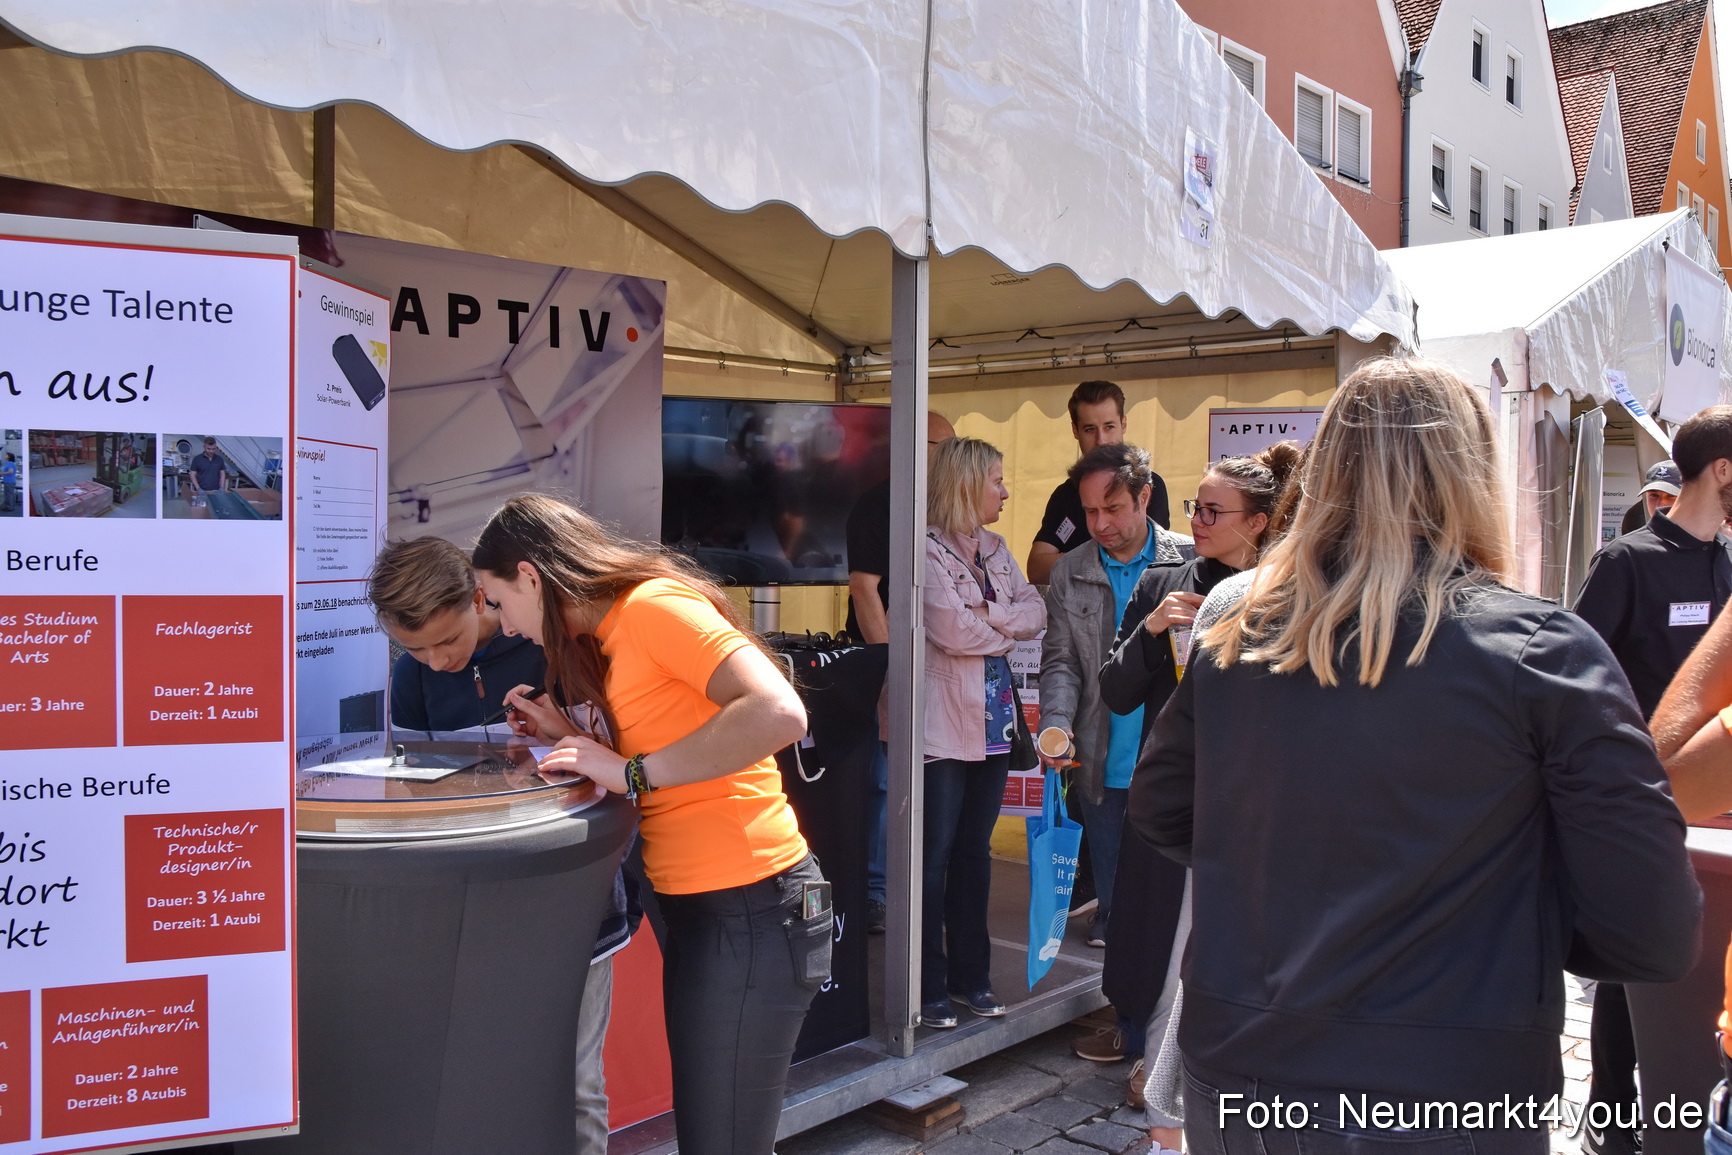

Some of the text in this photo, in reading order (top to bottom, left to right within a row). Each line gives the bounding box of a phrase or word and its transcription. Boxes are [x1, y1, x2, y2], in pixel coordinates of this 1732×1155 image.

[1200, 223, 1209, 240] 31
[103, 290, 234, 324] Talente
[320, 295, 374, 326] Gewinnspiel
[391, 286, 611, 353] APTIV
[1687, 328, 1716, 369] Bionorica
[48, 364, 154, 403] aus!
[326, 383, 342, 394] 2. Preis
[317, 394, 351, 408] Solar-Powerbank
[1228, 424, 1288, 435] APTIV
[7, 550, 99, 572] Berufe
[301, 602, 314, 610] zum
[314, 599, 338, 609] 29.06.18
[24, 611, 98, 626] Studium
[74, 629, 91, 645] of
[155, 621, 253, 639] Fachlagerist
[315, 630, 329, 640] Ende
[329, 628, 337, 639] Juli
[339, 628, 344, 637] in
[345, 627, 360, 637] unser
[360, 625, 374, 635] Werk
[10, 650, 50, 664] Arts
[304, 645, 334, 659] eingeladen
[154, 682, 254, 698] Dauer: 2 Jahre
[30, 696, 42, 712] 3
[46, 699, 85, 712] Jahre
[149, 706, 259, 722] Derzeit: 1 Azubi
[2, 773, 171, 801] ische Berufe
[153, 821, 259, 840] Technische/r
[168, 840, 244, 857] Produkt-
[160, 857, 252, 877] designer/in
[1052, 853, 1078, 866] Save
[1057, 868, 1065, 880] It
[147, 889, 266, 908] Dauer: 3 ½ Jahre
[153, 912, 261, 932] Derzeit: 1 Azubi
[57, 999, 196, 1026] Maschinen- und
[52, 1017, 200, 1044] Anlagenführer/in
[75, 1062, 180, 1086] Dauer: 2 Jahre
[67, 1085, 188, 1110] Derzeit: 8 Azubis
